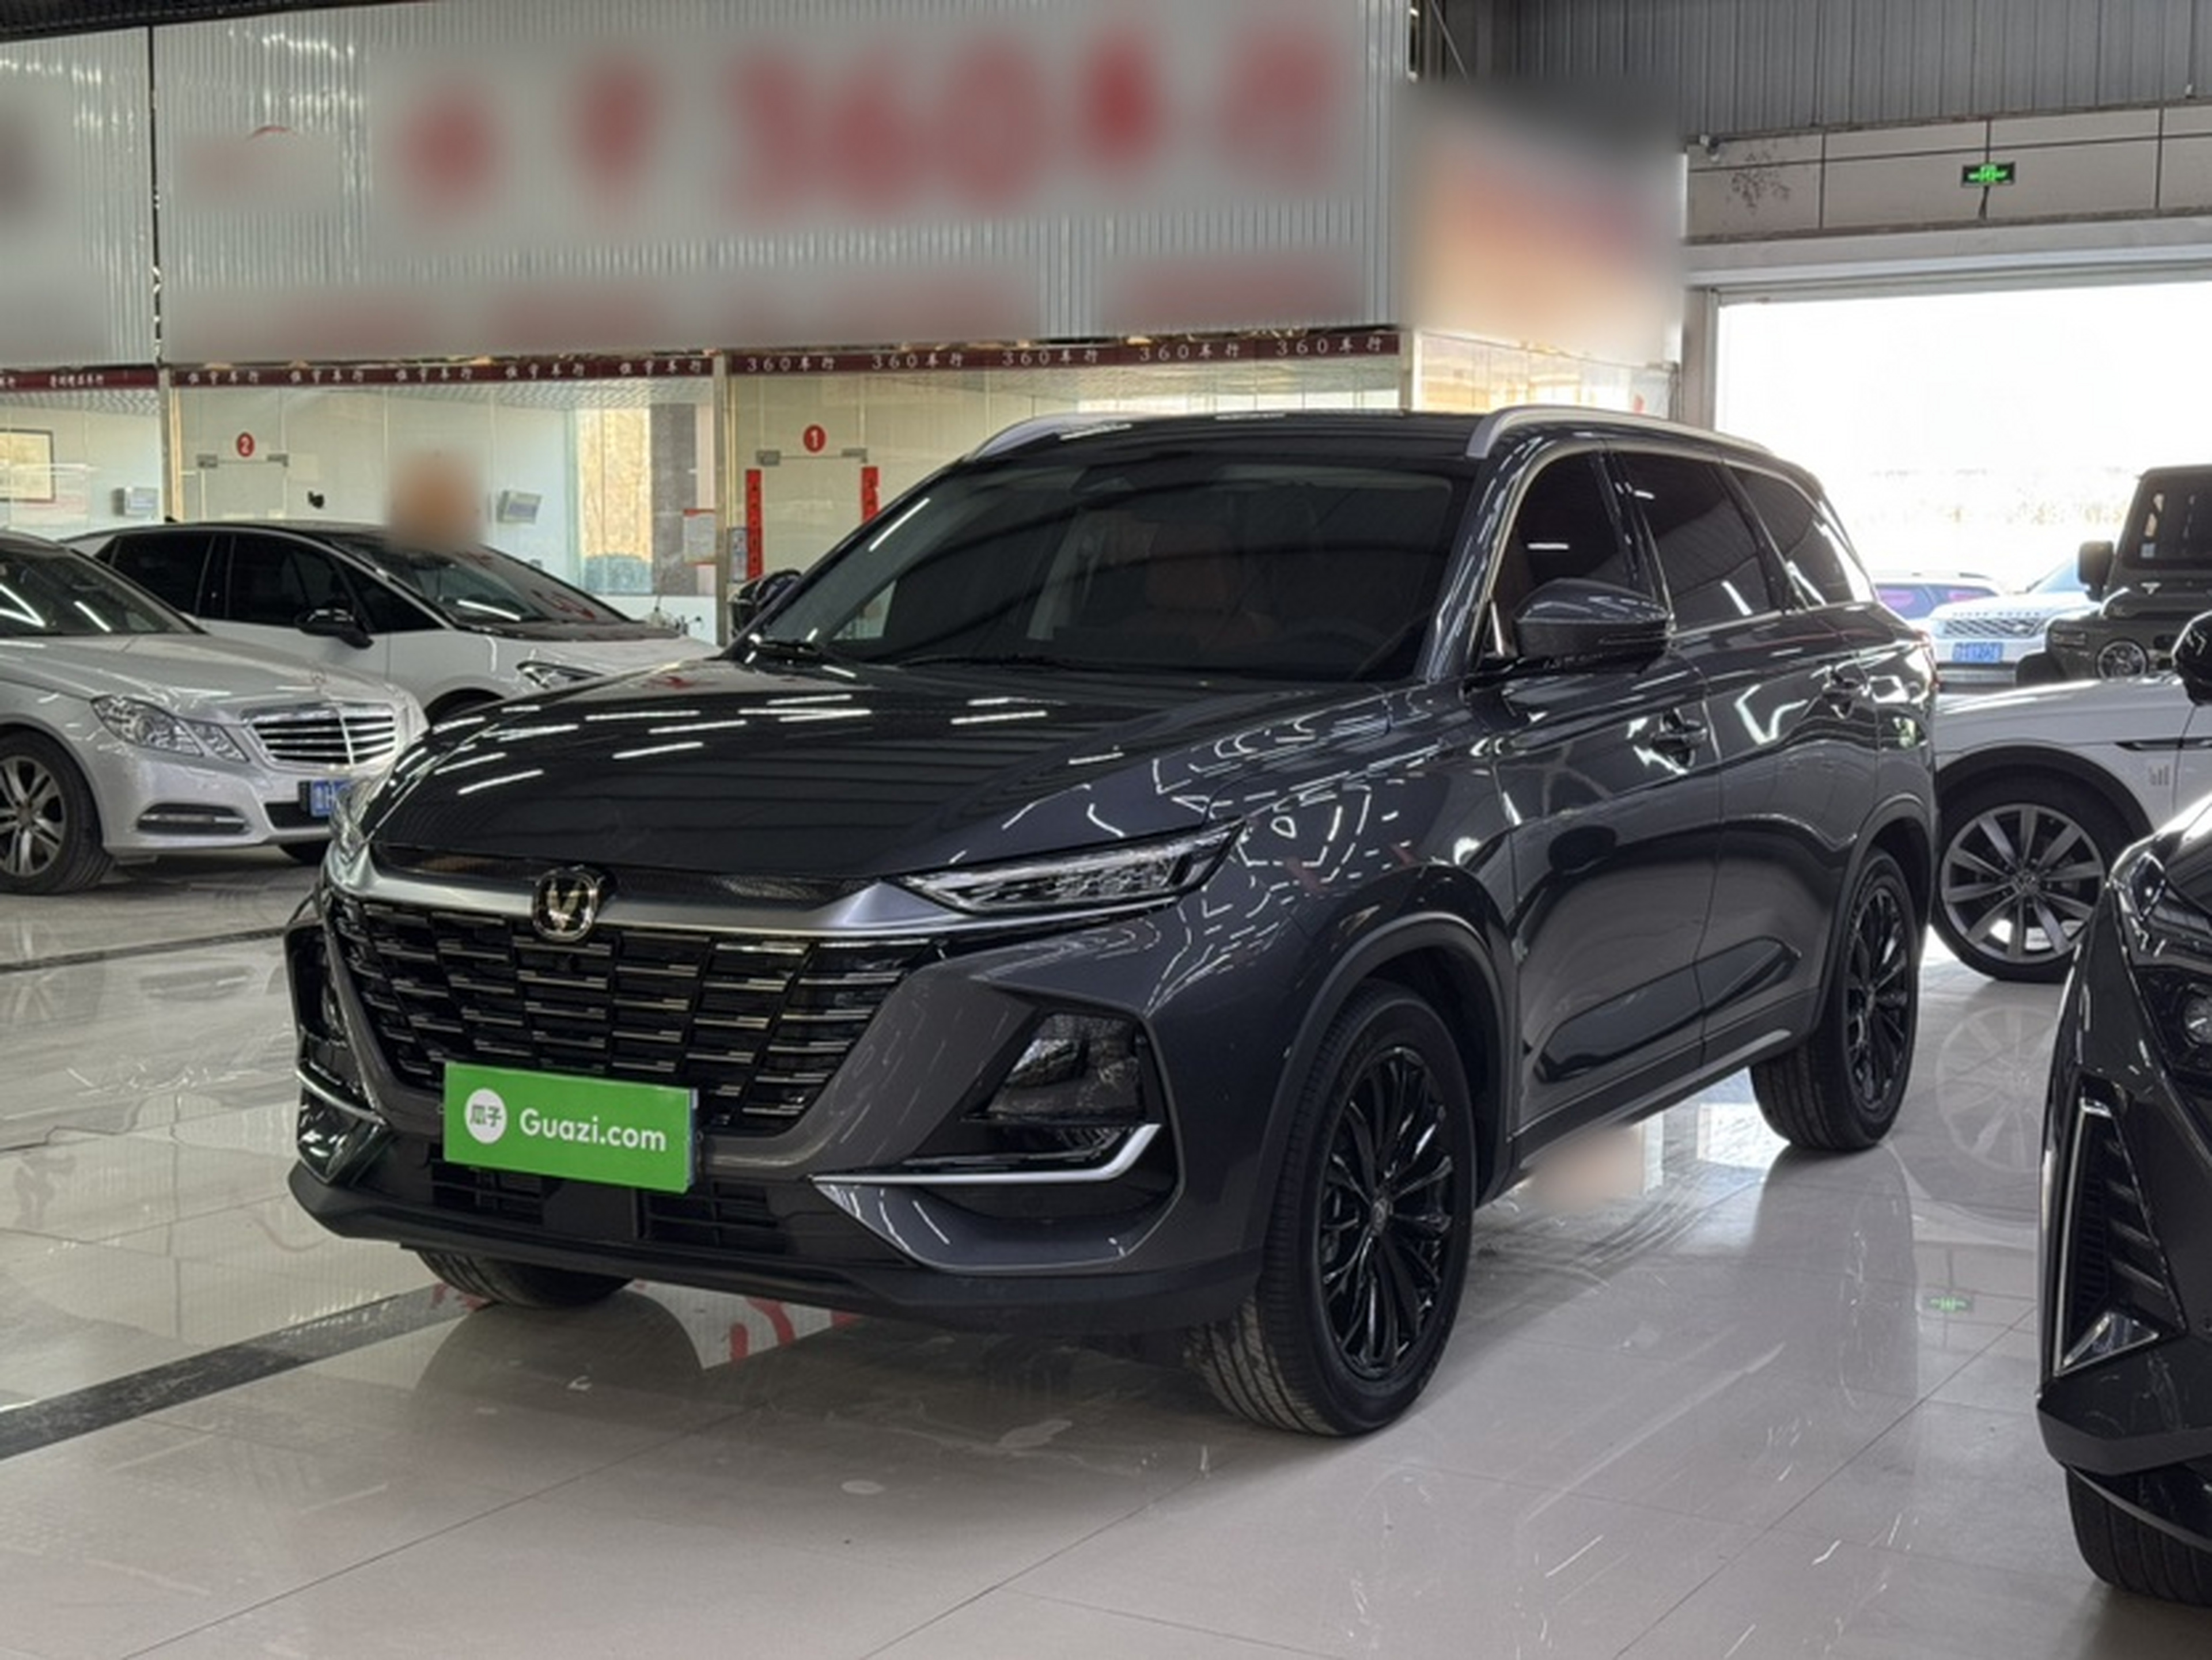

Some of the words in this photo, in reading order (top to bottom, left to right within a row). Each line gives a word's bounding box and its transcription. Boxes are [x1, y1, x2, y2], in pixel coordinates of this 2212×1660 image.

[240, 436, 250, 454] 2
[810, 430, 819, 448] 1
[469, 1105, 502, 1128] 瓜子
[520, 1107, 666, 1153] Guazi.com
